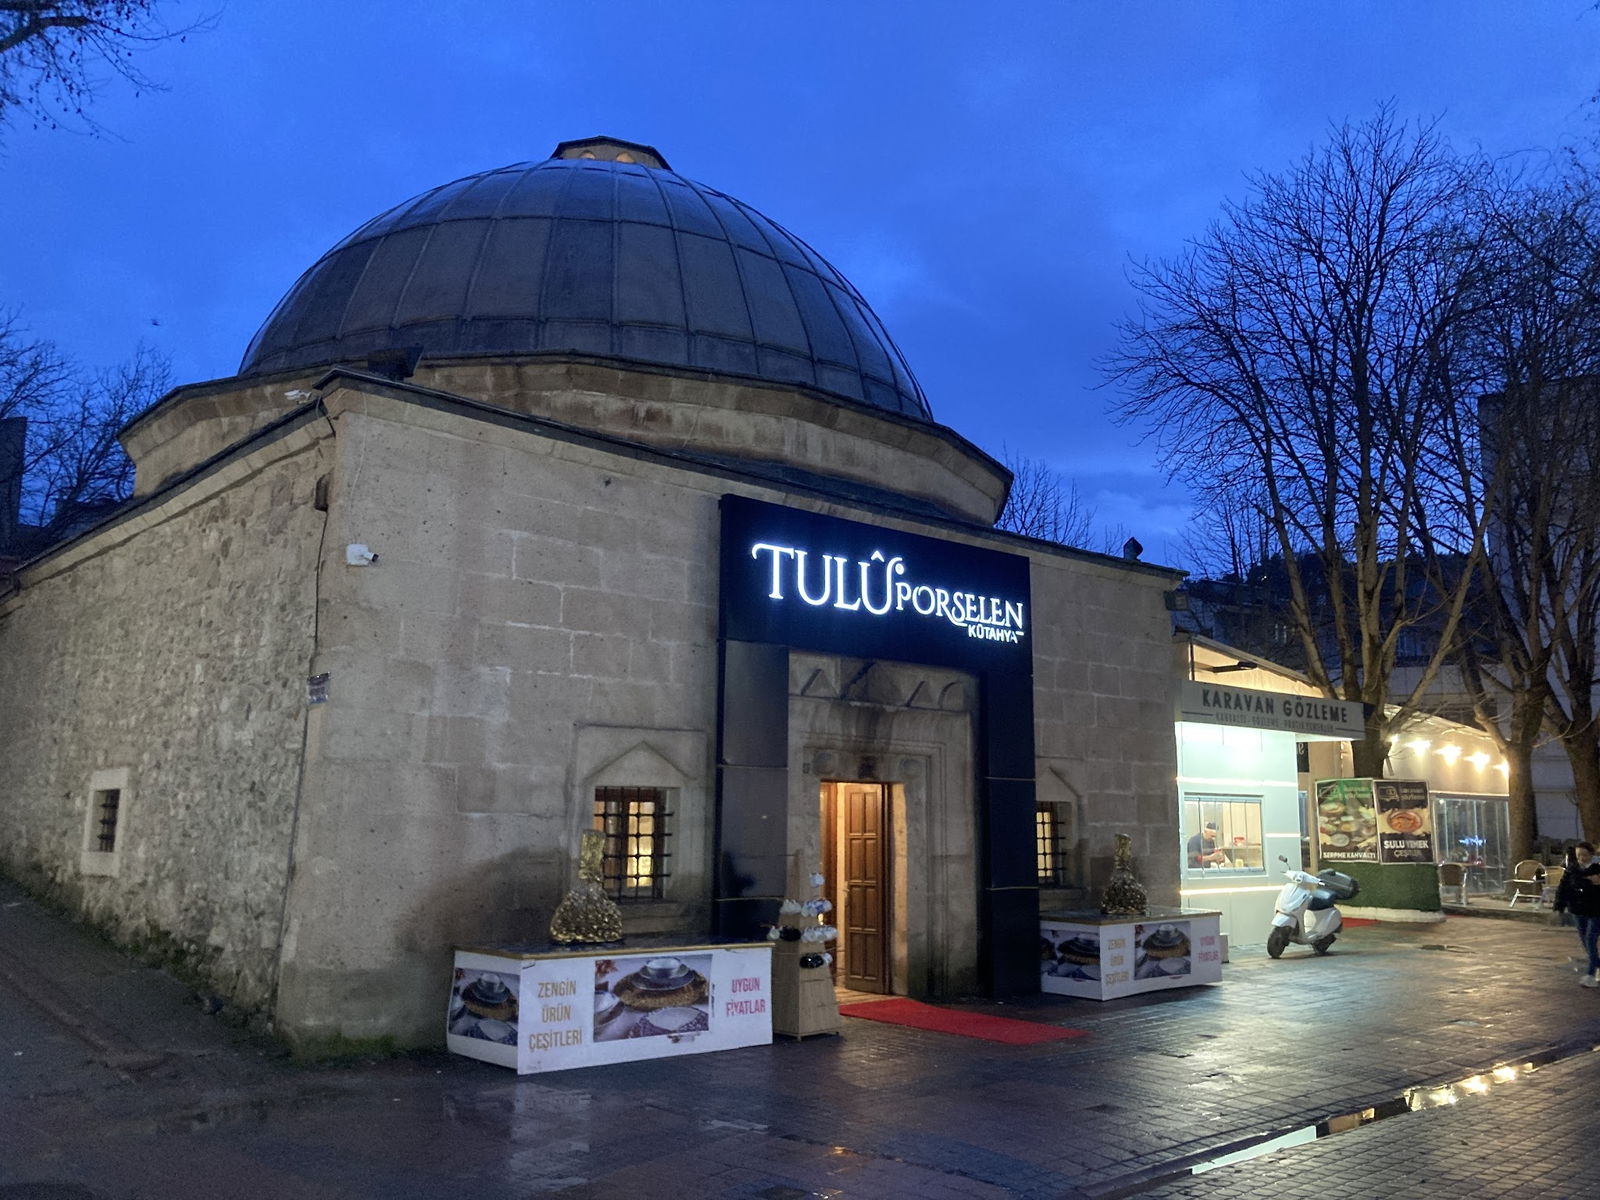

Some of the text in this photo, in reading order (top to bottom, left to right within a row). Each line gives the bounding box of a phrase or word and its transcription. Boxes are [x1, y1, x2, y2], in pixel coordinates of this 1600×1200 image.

[895, 582, 1023, 629] PORSELEN
[1202, 689, 1274, 715] KARAVAN
[1283, 696, 1348, 723] GÖZLEME
[1383, 840, 1405, 849] SULU
[537, 978, 577, 998] ZENGİN
[731, 977, 760, 993] UYGUN
[541, 1003, 572, 1023] ÜRÜN
[726, 998, 766, 1017] FİYATLAR
[528, 1029, 582, 1054] ÇEŞİTLERİ
